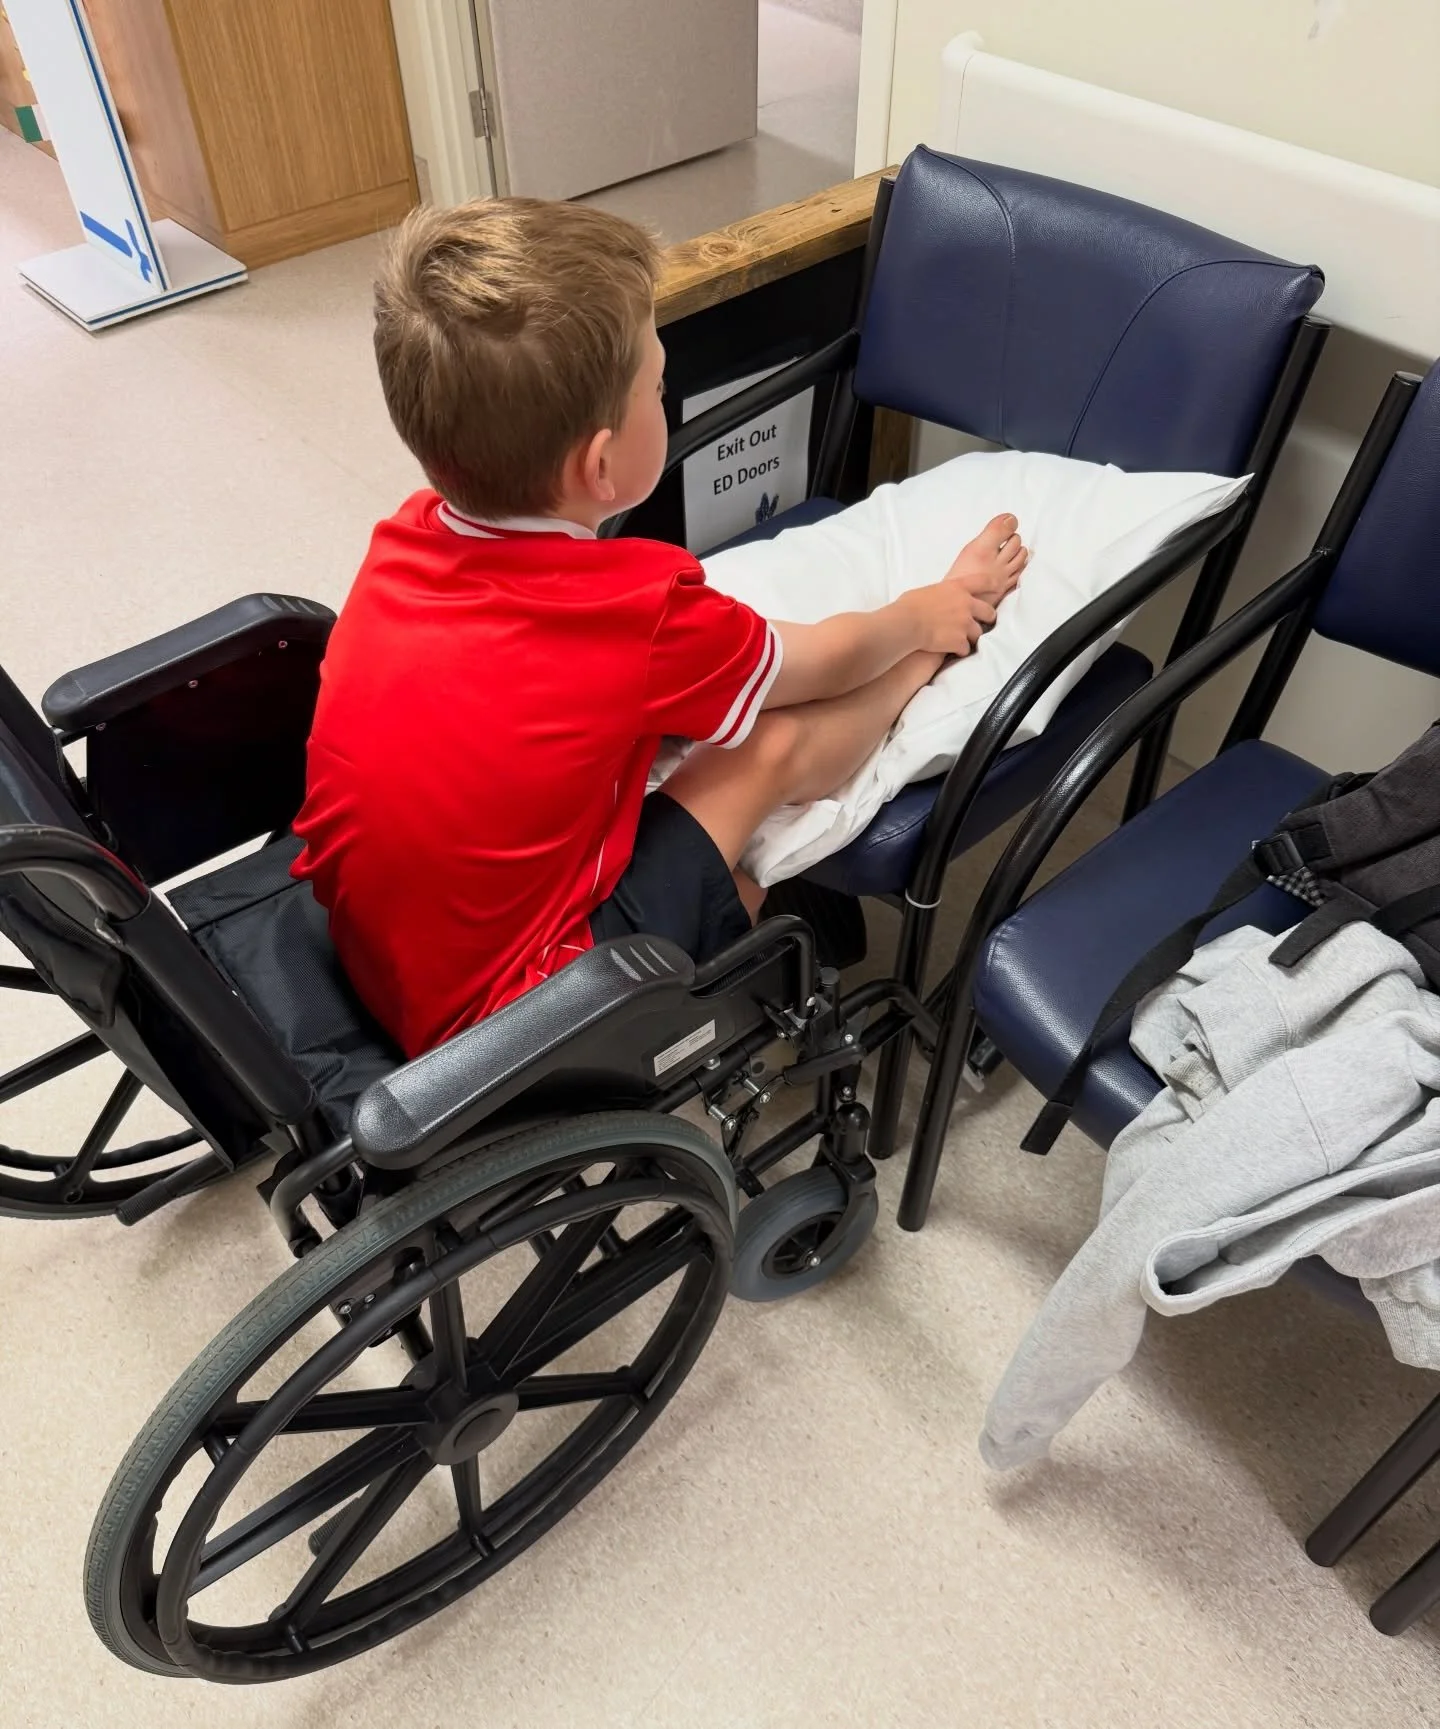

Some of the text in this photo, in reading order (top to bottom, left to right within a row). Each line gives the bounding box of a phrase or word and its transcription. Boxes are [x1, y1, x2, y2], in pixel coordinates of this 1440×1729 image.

[717, 424, 777, 461] Exit Out
[713, 457, 780, 495] ED Doors
